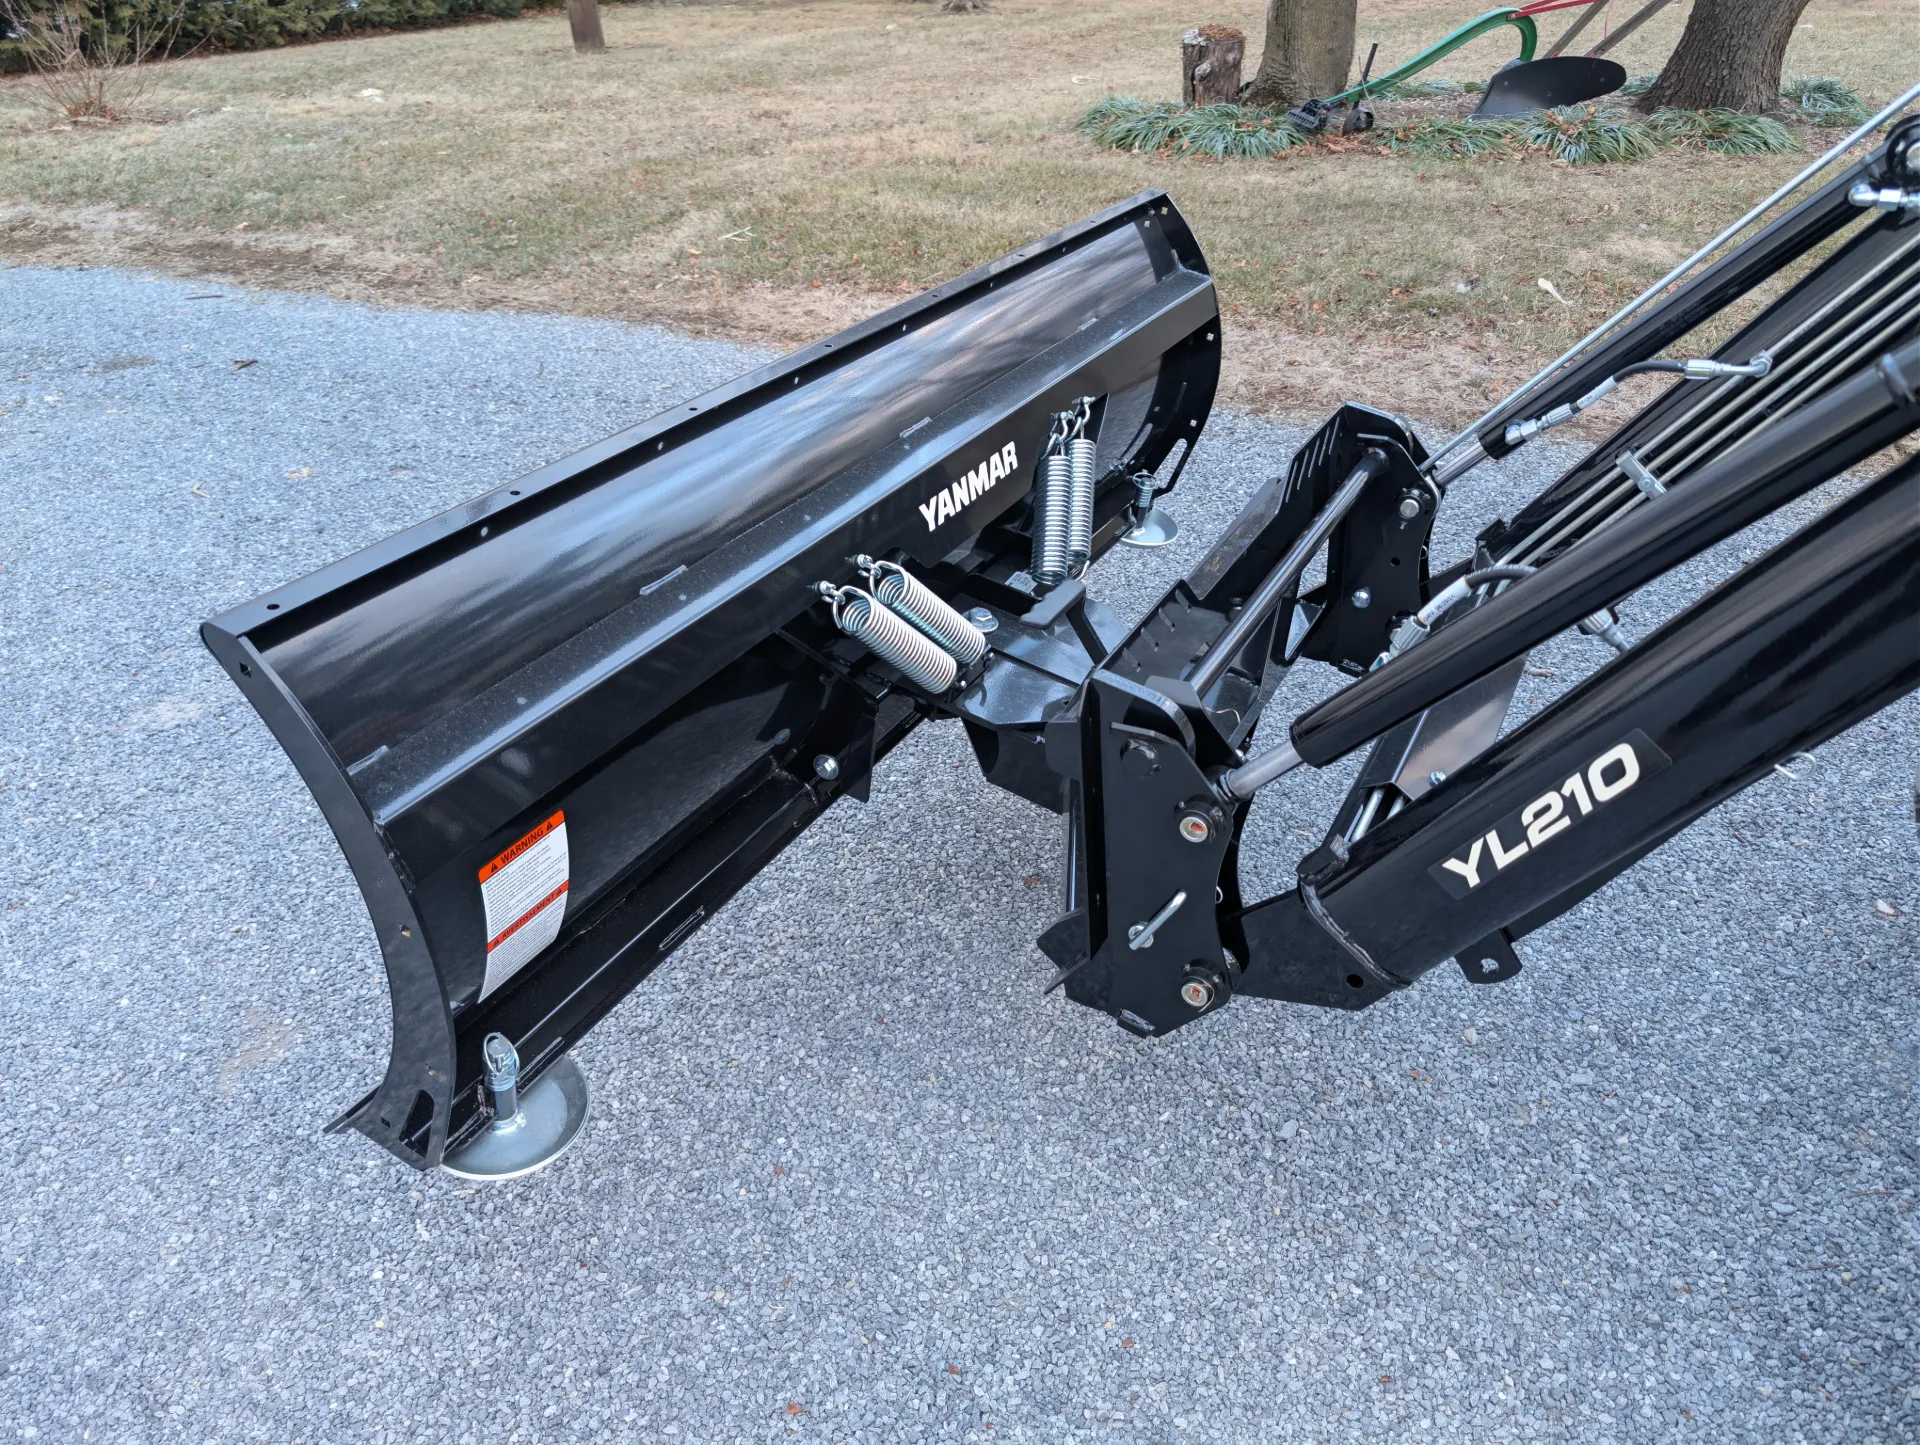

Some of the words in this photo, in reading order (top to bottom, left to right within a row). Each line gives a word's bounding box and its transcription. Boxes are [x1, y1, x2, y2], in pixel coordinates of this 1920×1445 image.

[918, 440, 1018, 532] YANMAR
[500, 827, 544, 864] WARNING
[1442, 742, 1640, 889] YL210
[502, 893, 555, 938] AVERTISSEMENT
